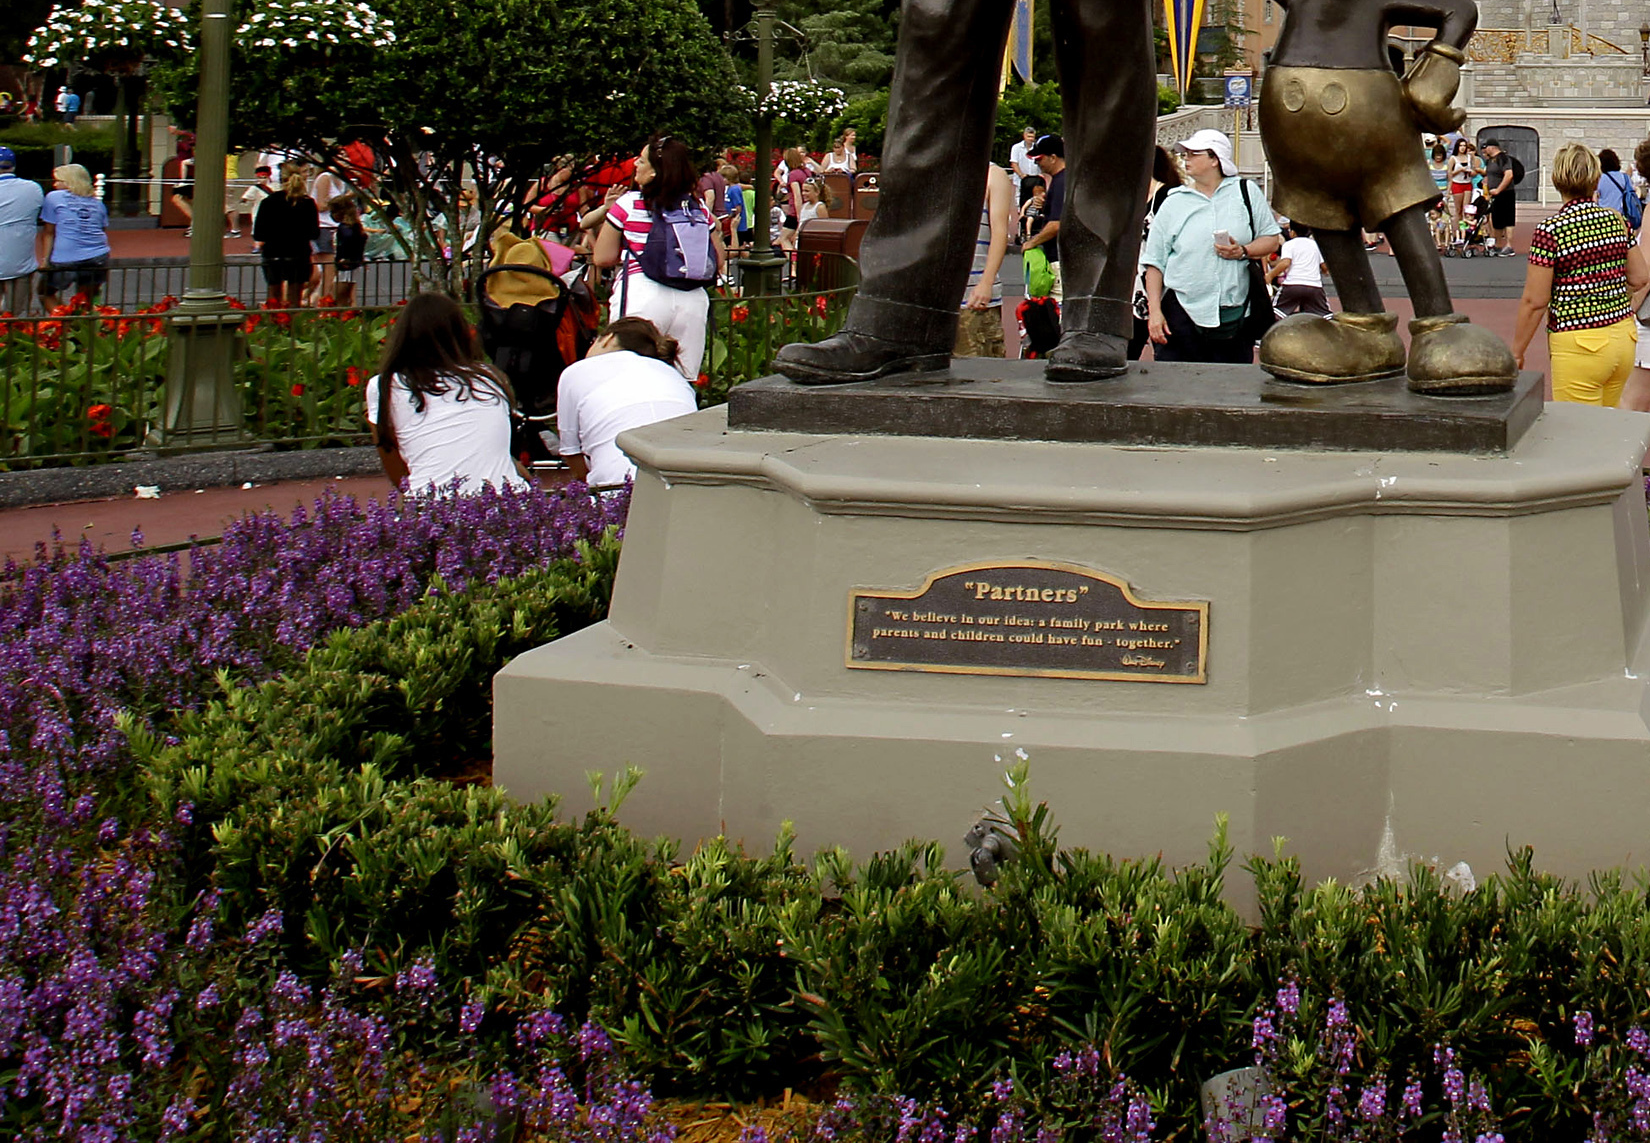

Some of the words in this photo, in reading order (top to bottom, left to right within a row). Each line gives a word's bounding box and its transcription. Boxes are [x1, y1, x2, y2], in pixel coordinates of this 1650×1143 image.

[964, 581, 1089, 603] “Partners”
[912, 611, 957, 623] believe
[960, 613, 975, 624] in
[978, 616, 1000, 626] our
[1004, 615, 1034, 628] idea:
[1038, 619, 1046, 627] a
[1049, 617, 1091, 631] family
[1094, 619, 1125, 633] park
[1128, 620, 1169, 632] where
[872, 628, 920, 639] parents
[923, 628, 947, 640] and
[950, 629, 1005, 642] children
[1008, 633, 1044, 645] could
[1047, 633, 1078, 645] have
[1081, 635, 1103, 646] fun
